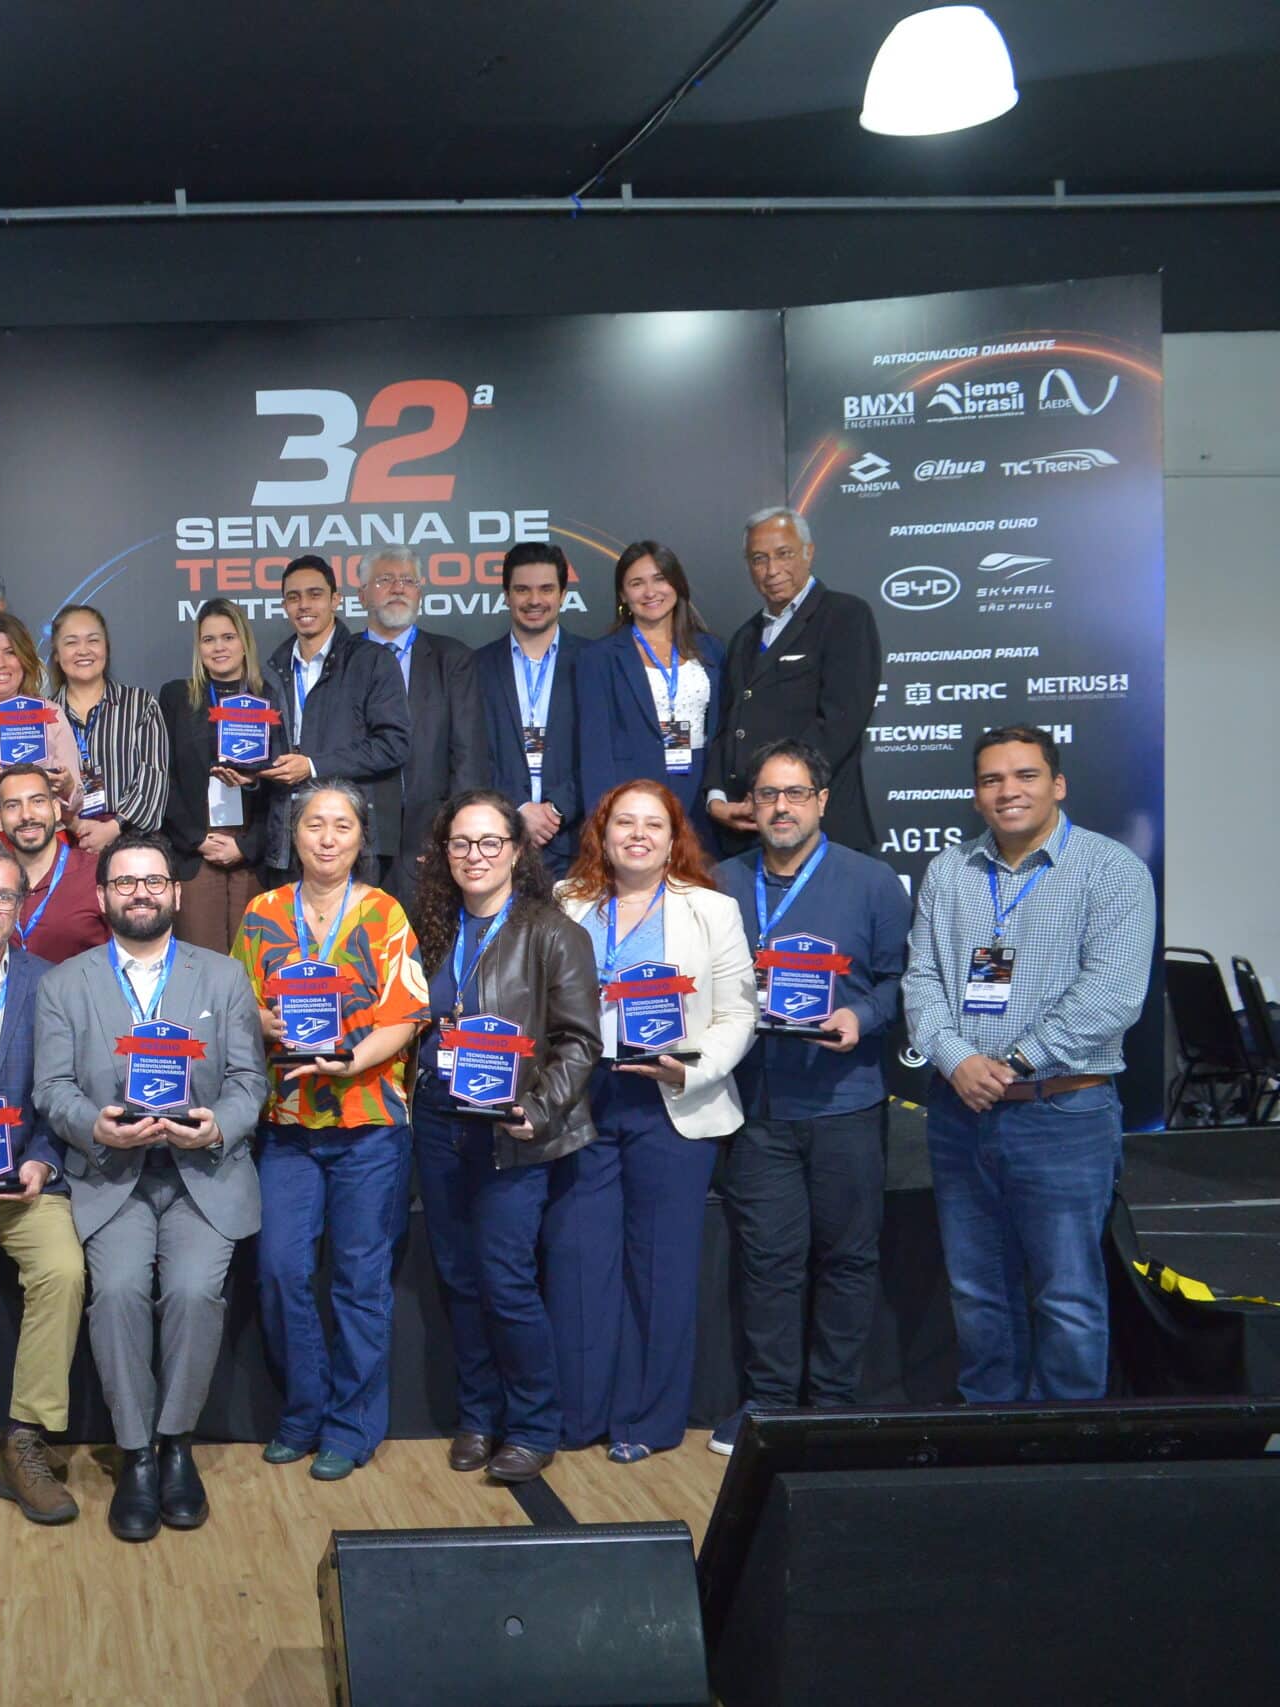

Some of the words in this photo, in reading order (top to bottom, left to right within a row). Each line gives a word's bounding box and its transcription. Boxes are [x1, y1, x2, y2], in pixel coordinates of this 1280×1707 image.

[873, 347, 978, 365] PATROCINADOR
[981, 339, 1056, 357] DIAMANTE
[964, 381, 1020, 398] ieme
[964, 393, 1025, 413] brasil
[844, 417, 916, 430] ENGENHARIA
[251, 378, 494, 506] 32ª
[840, 481, 900, 493] TRANSVIA
[176, 511, 454, 550] SEMANA
[469, 510, 550, 544] DE
[889, 519, 996, 537] PATROCINADOR
[998, 517, 1039, 530] OURO
[890, 579, 952, 597] BYD
[976, 584, 1056, 598] SKYRAIL
[978, 601, 1005, 612] SÃO
[1008, 600, 1054, 610] PAULO
[886, 648, 992, 663] PATROCINADOR
[995, 645, 1040, 659] PRATA
[936, 682, 1008, 701] CRRC
[1027, 675, 1108, 694] METRUS
[866, 724, 962, 742] TECWISE
[874, 744, 918, 753] INOVAÇÃO
[920, 743, 953, 751] DIGITAL
[888, 788, 974, 801] PATROCINAD
[881, 827, 963, 852] AGIS
